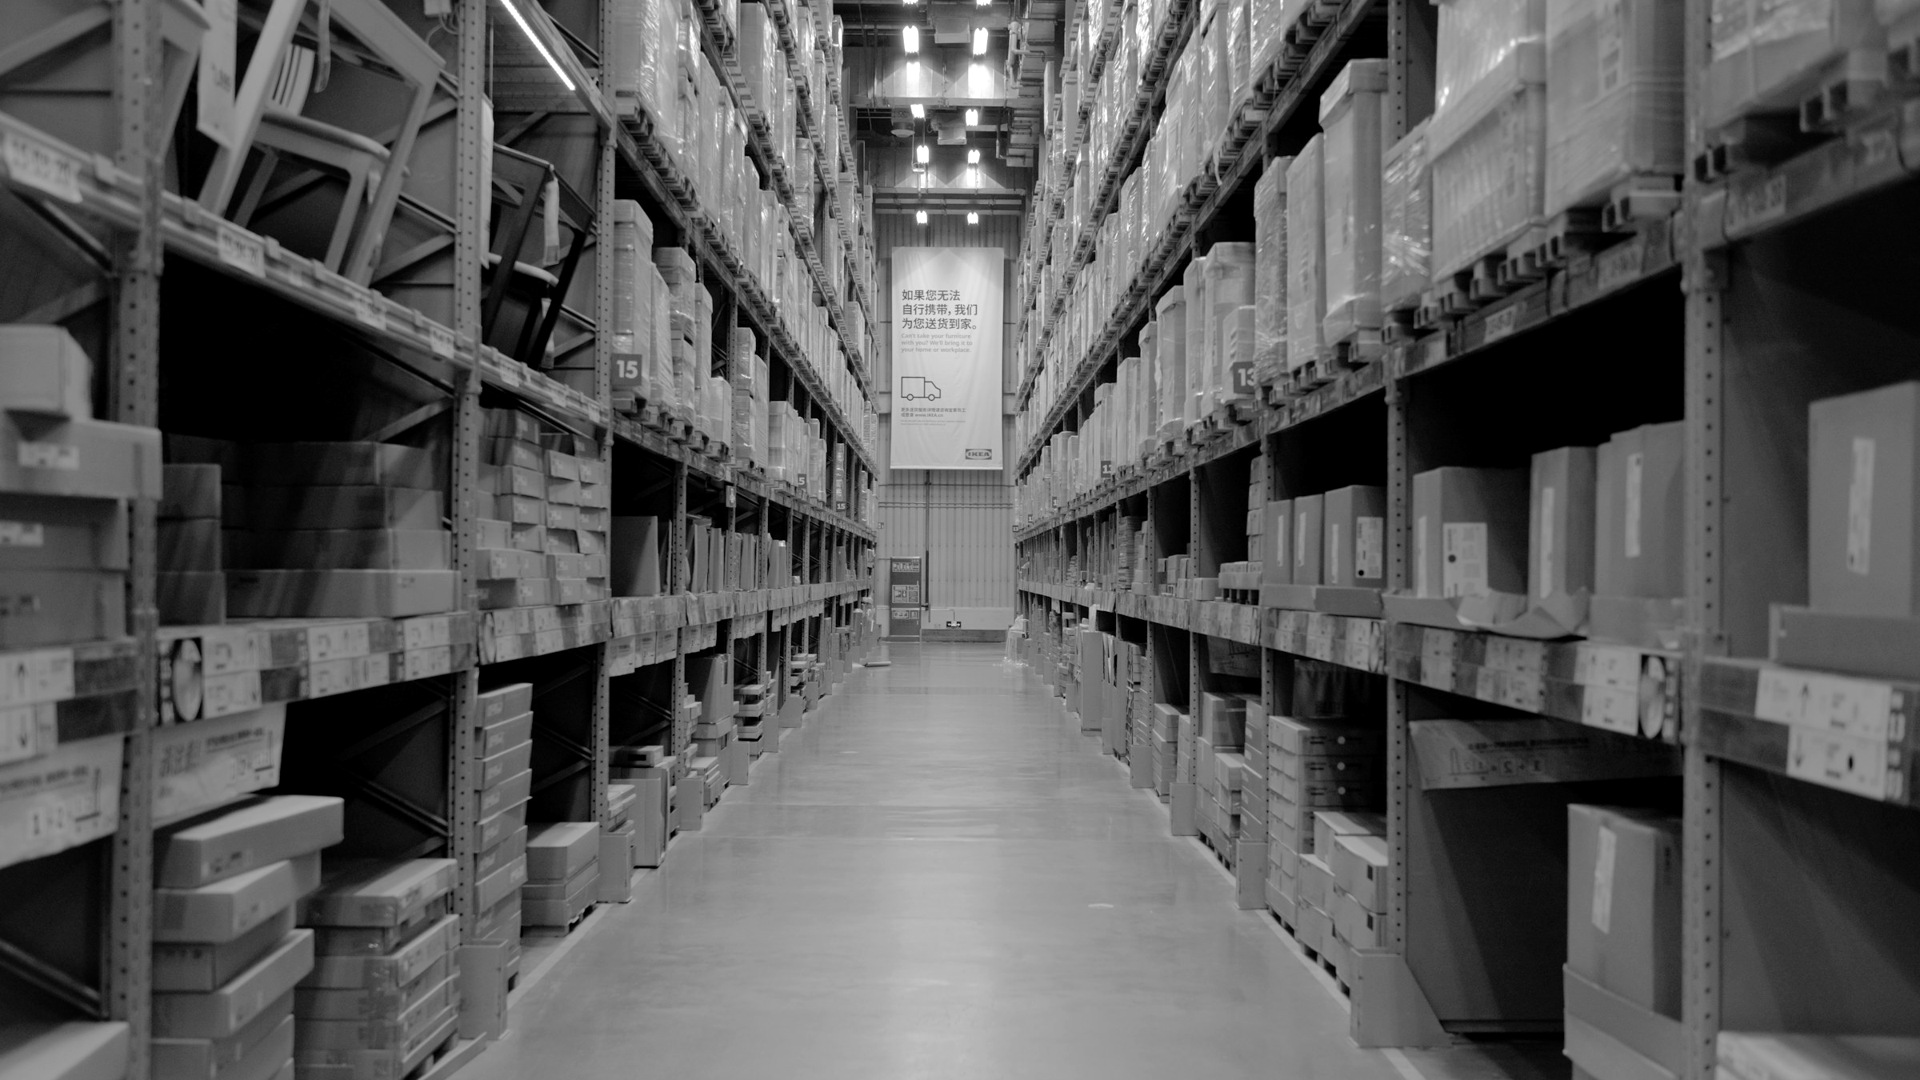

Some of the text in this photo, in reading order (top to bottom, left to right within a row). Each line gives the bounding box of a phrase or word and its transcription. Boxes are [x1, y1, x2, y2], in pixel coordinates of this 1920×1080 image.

[902, 289, 961, 301] 如果您无法
[902, 318, 977, 330] 为您送货到家。
[616, 359, 638, 379] 15
